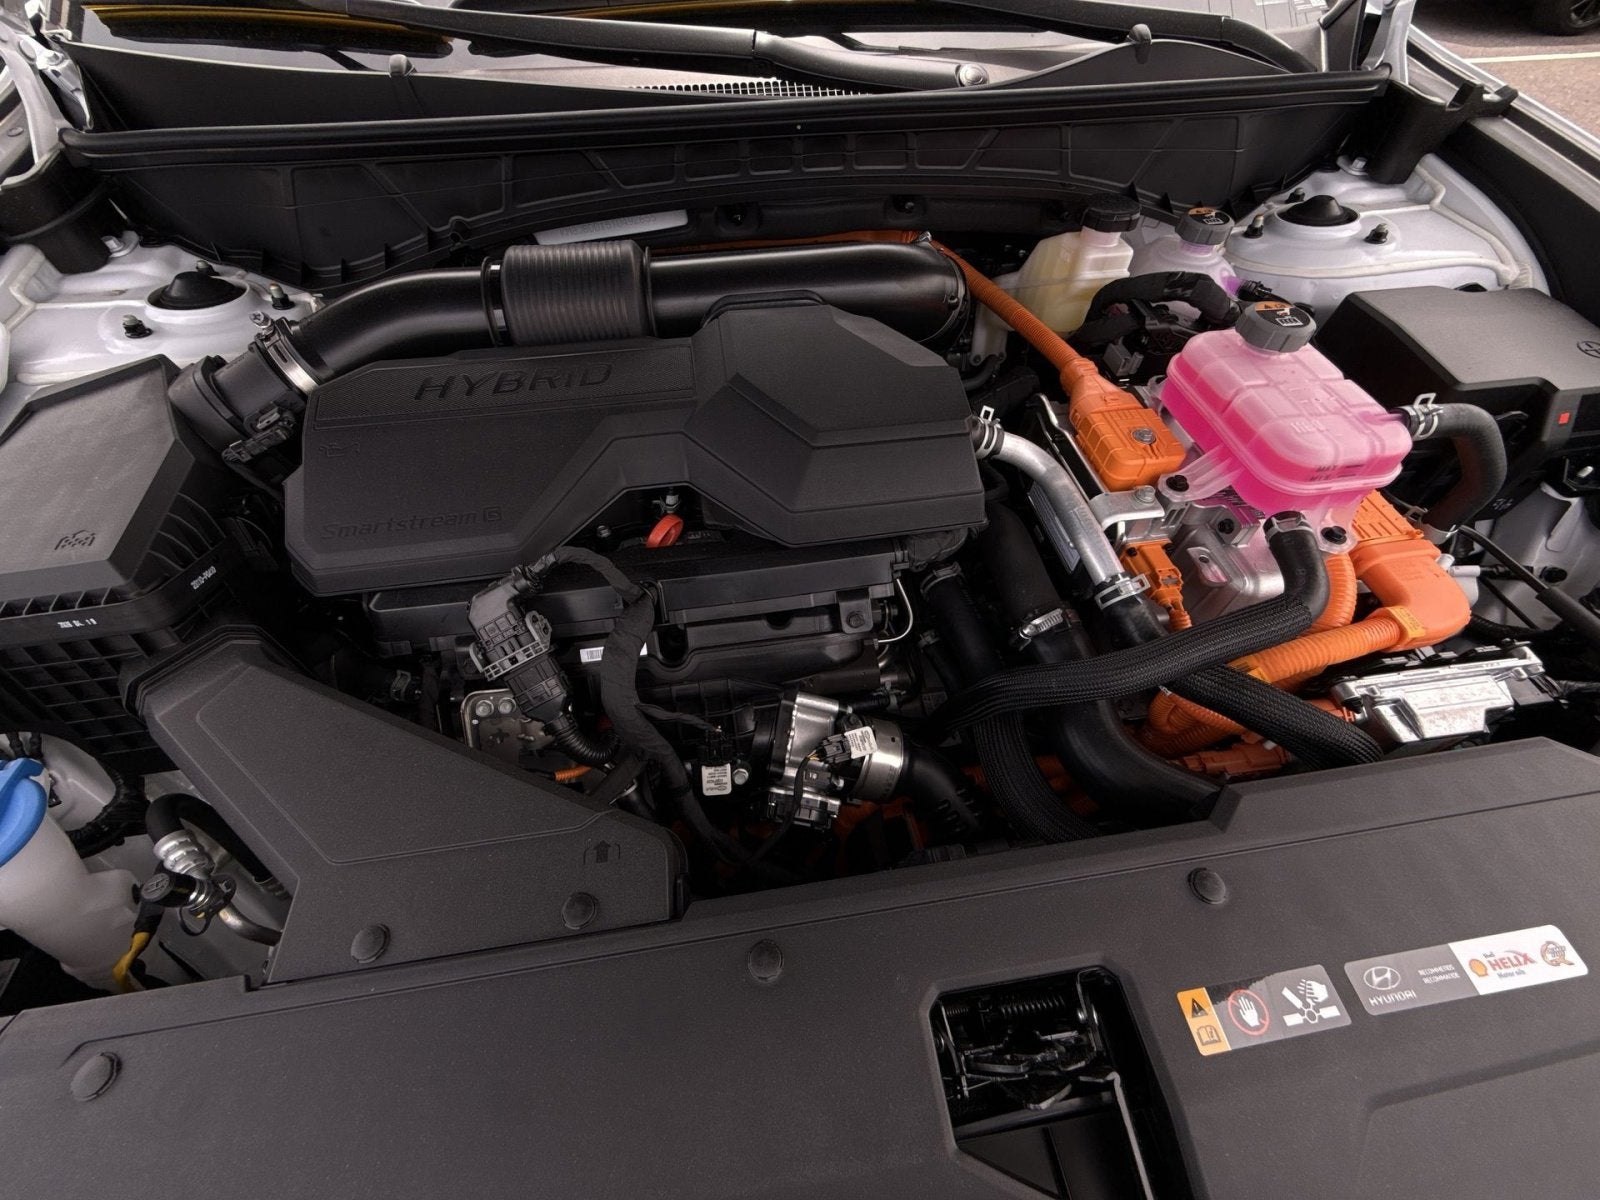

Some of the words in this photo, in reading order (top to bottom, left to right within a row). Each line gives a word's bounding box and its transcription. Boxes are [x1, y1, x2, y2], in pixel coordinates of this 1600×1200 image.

[414, 363, 613, 400] HYBRID
[319, 509, 478, 540] Smartstream
[1487, 952, 1537, 971] HELIX
[1369, 990, 1417, 1007] HYUNDAI
